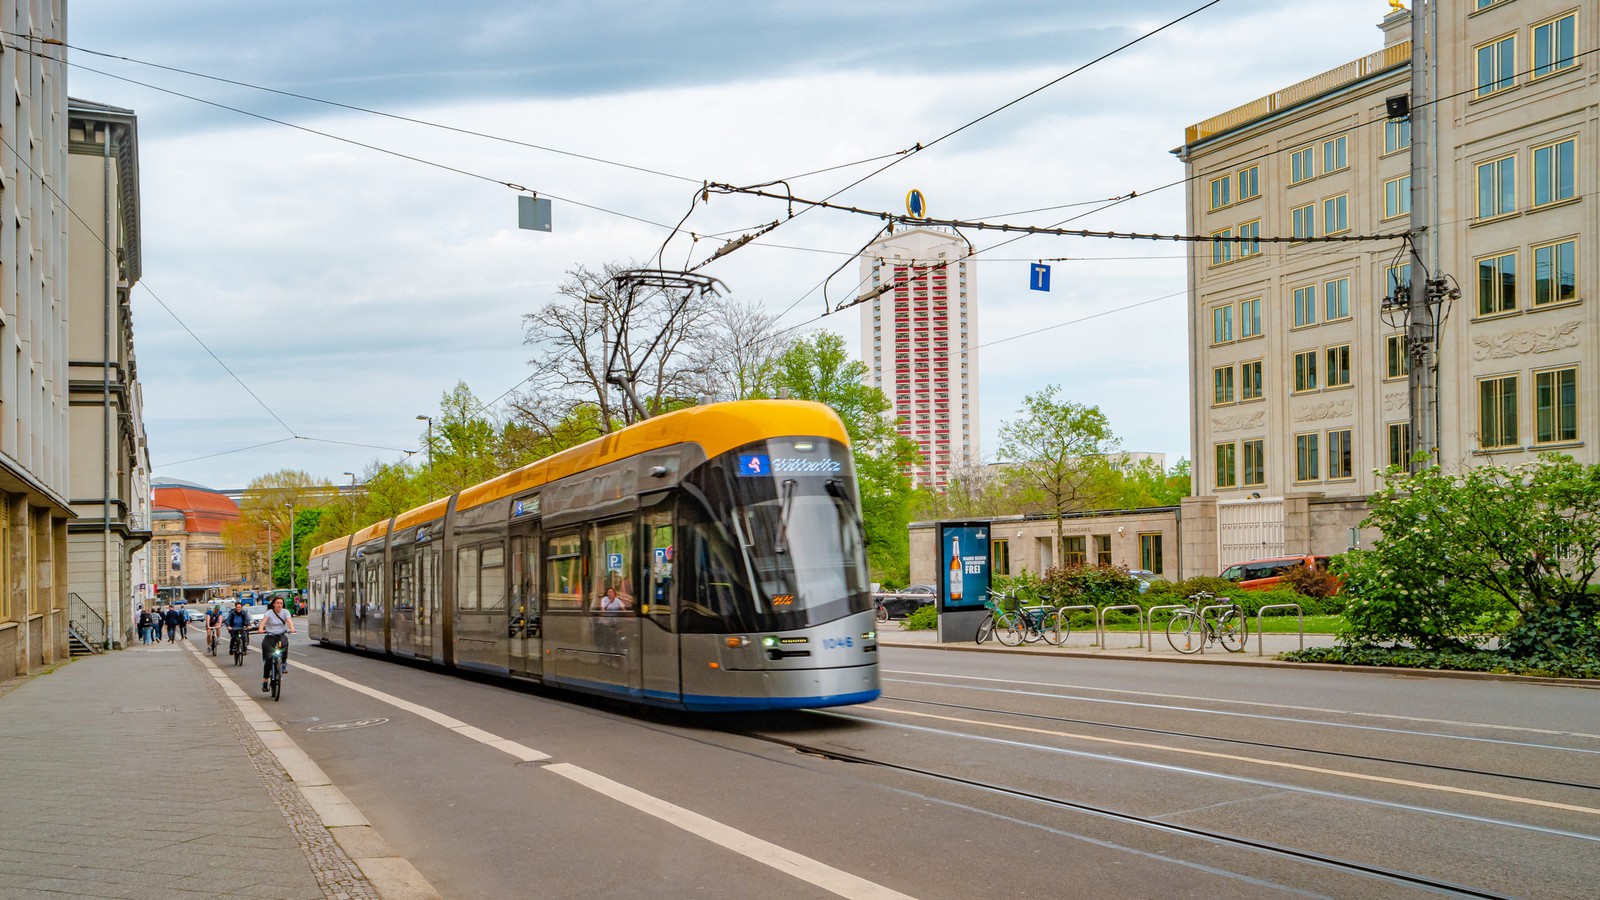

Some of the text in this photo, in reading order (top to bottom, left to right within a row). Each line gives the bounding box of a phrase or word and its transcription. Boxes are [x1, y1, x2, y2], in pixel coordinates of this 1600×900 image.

[748, 457, 760, 473] 4
[610, 555, 619, 568] P
[965, 565, 981, 574] FREI
